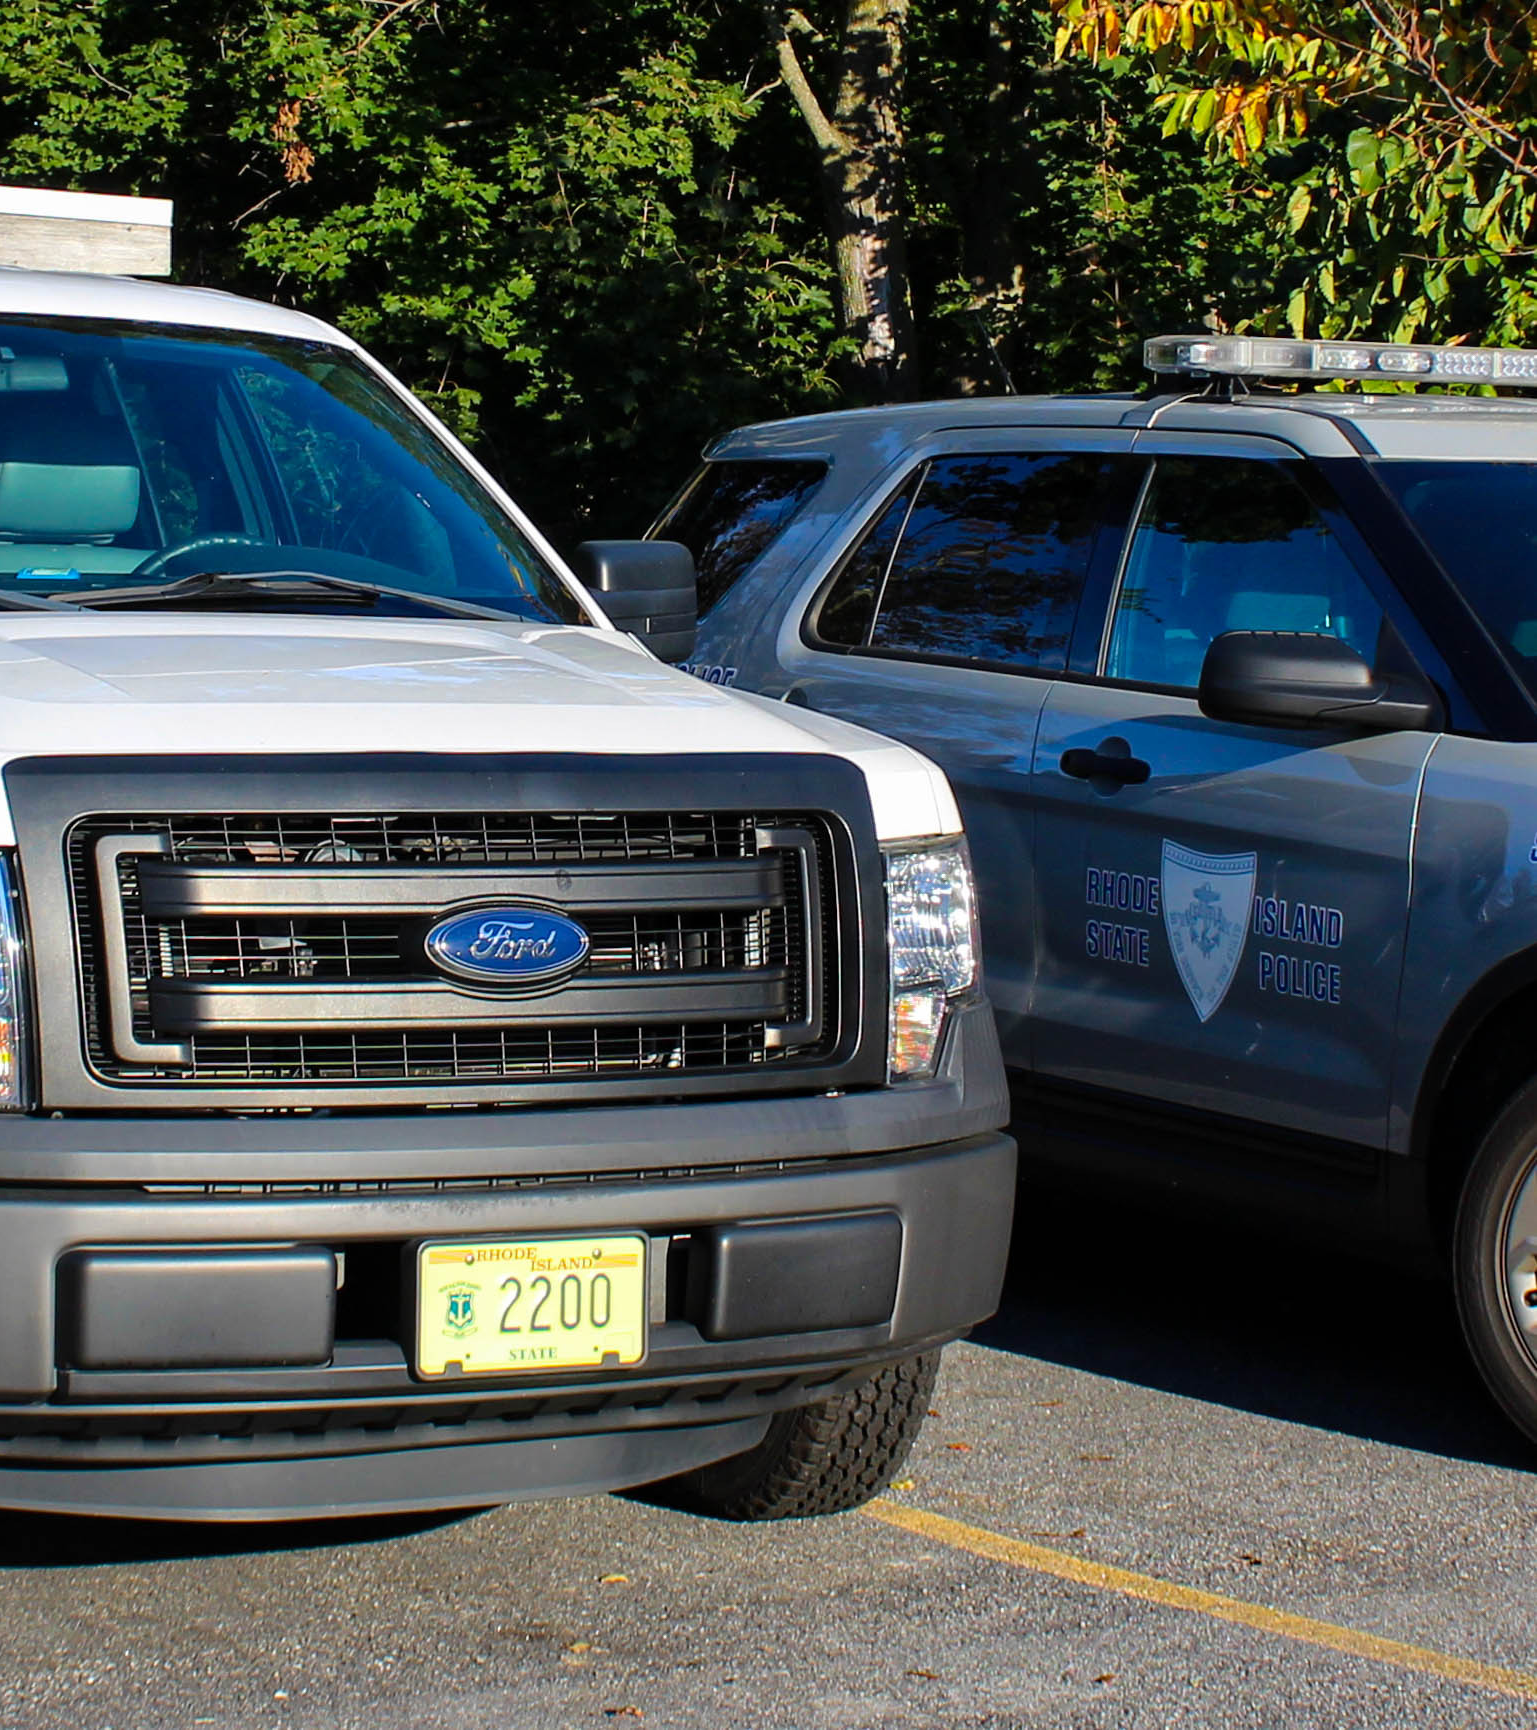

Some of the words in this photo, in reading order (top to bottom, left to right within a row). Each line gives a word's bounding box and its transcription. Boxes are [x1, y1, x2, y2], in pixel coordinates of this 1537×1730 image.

[1086, 867, 1159, 916] RHODE
[1253, 896, 1344, 949] ISLAND
[470, 920, 557, 961] Ford
[1086, 920, 1150, 967] STATE
[1259, 952, 1341, 1005] POLICE
[476, 1247, 538, 1262] RHODE
[530, 1257, 593, 1272] ISLAND
[499, 1273, 611, 1334] 2200
[509, 1347, 558, 1361] STATE
